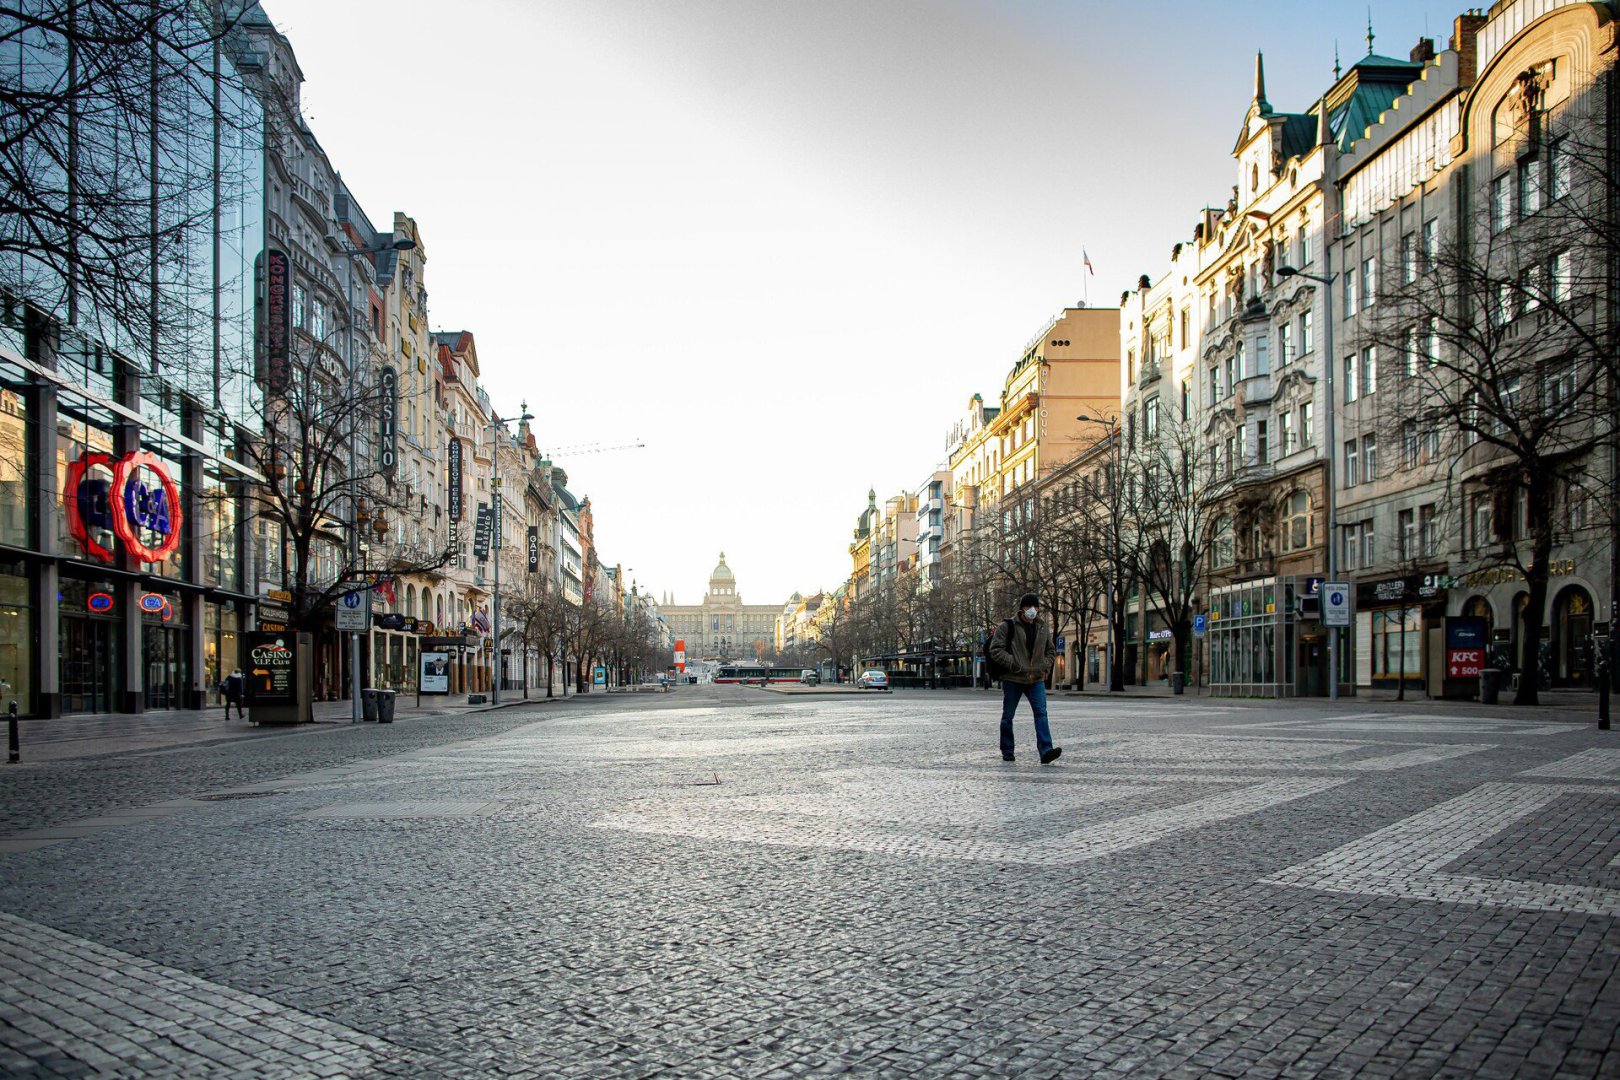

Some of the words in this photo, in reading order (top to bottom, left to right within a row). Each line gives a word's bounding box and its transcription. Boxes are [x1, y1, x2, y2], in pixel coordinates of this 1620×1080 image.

[382, 373, 394, 466] CASINO
[481, 515, 491, 556] RESERVED
[1196, 617, 1204, 627] P
[1452, 651, 1479, 662] KFC
